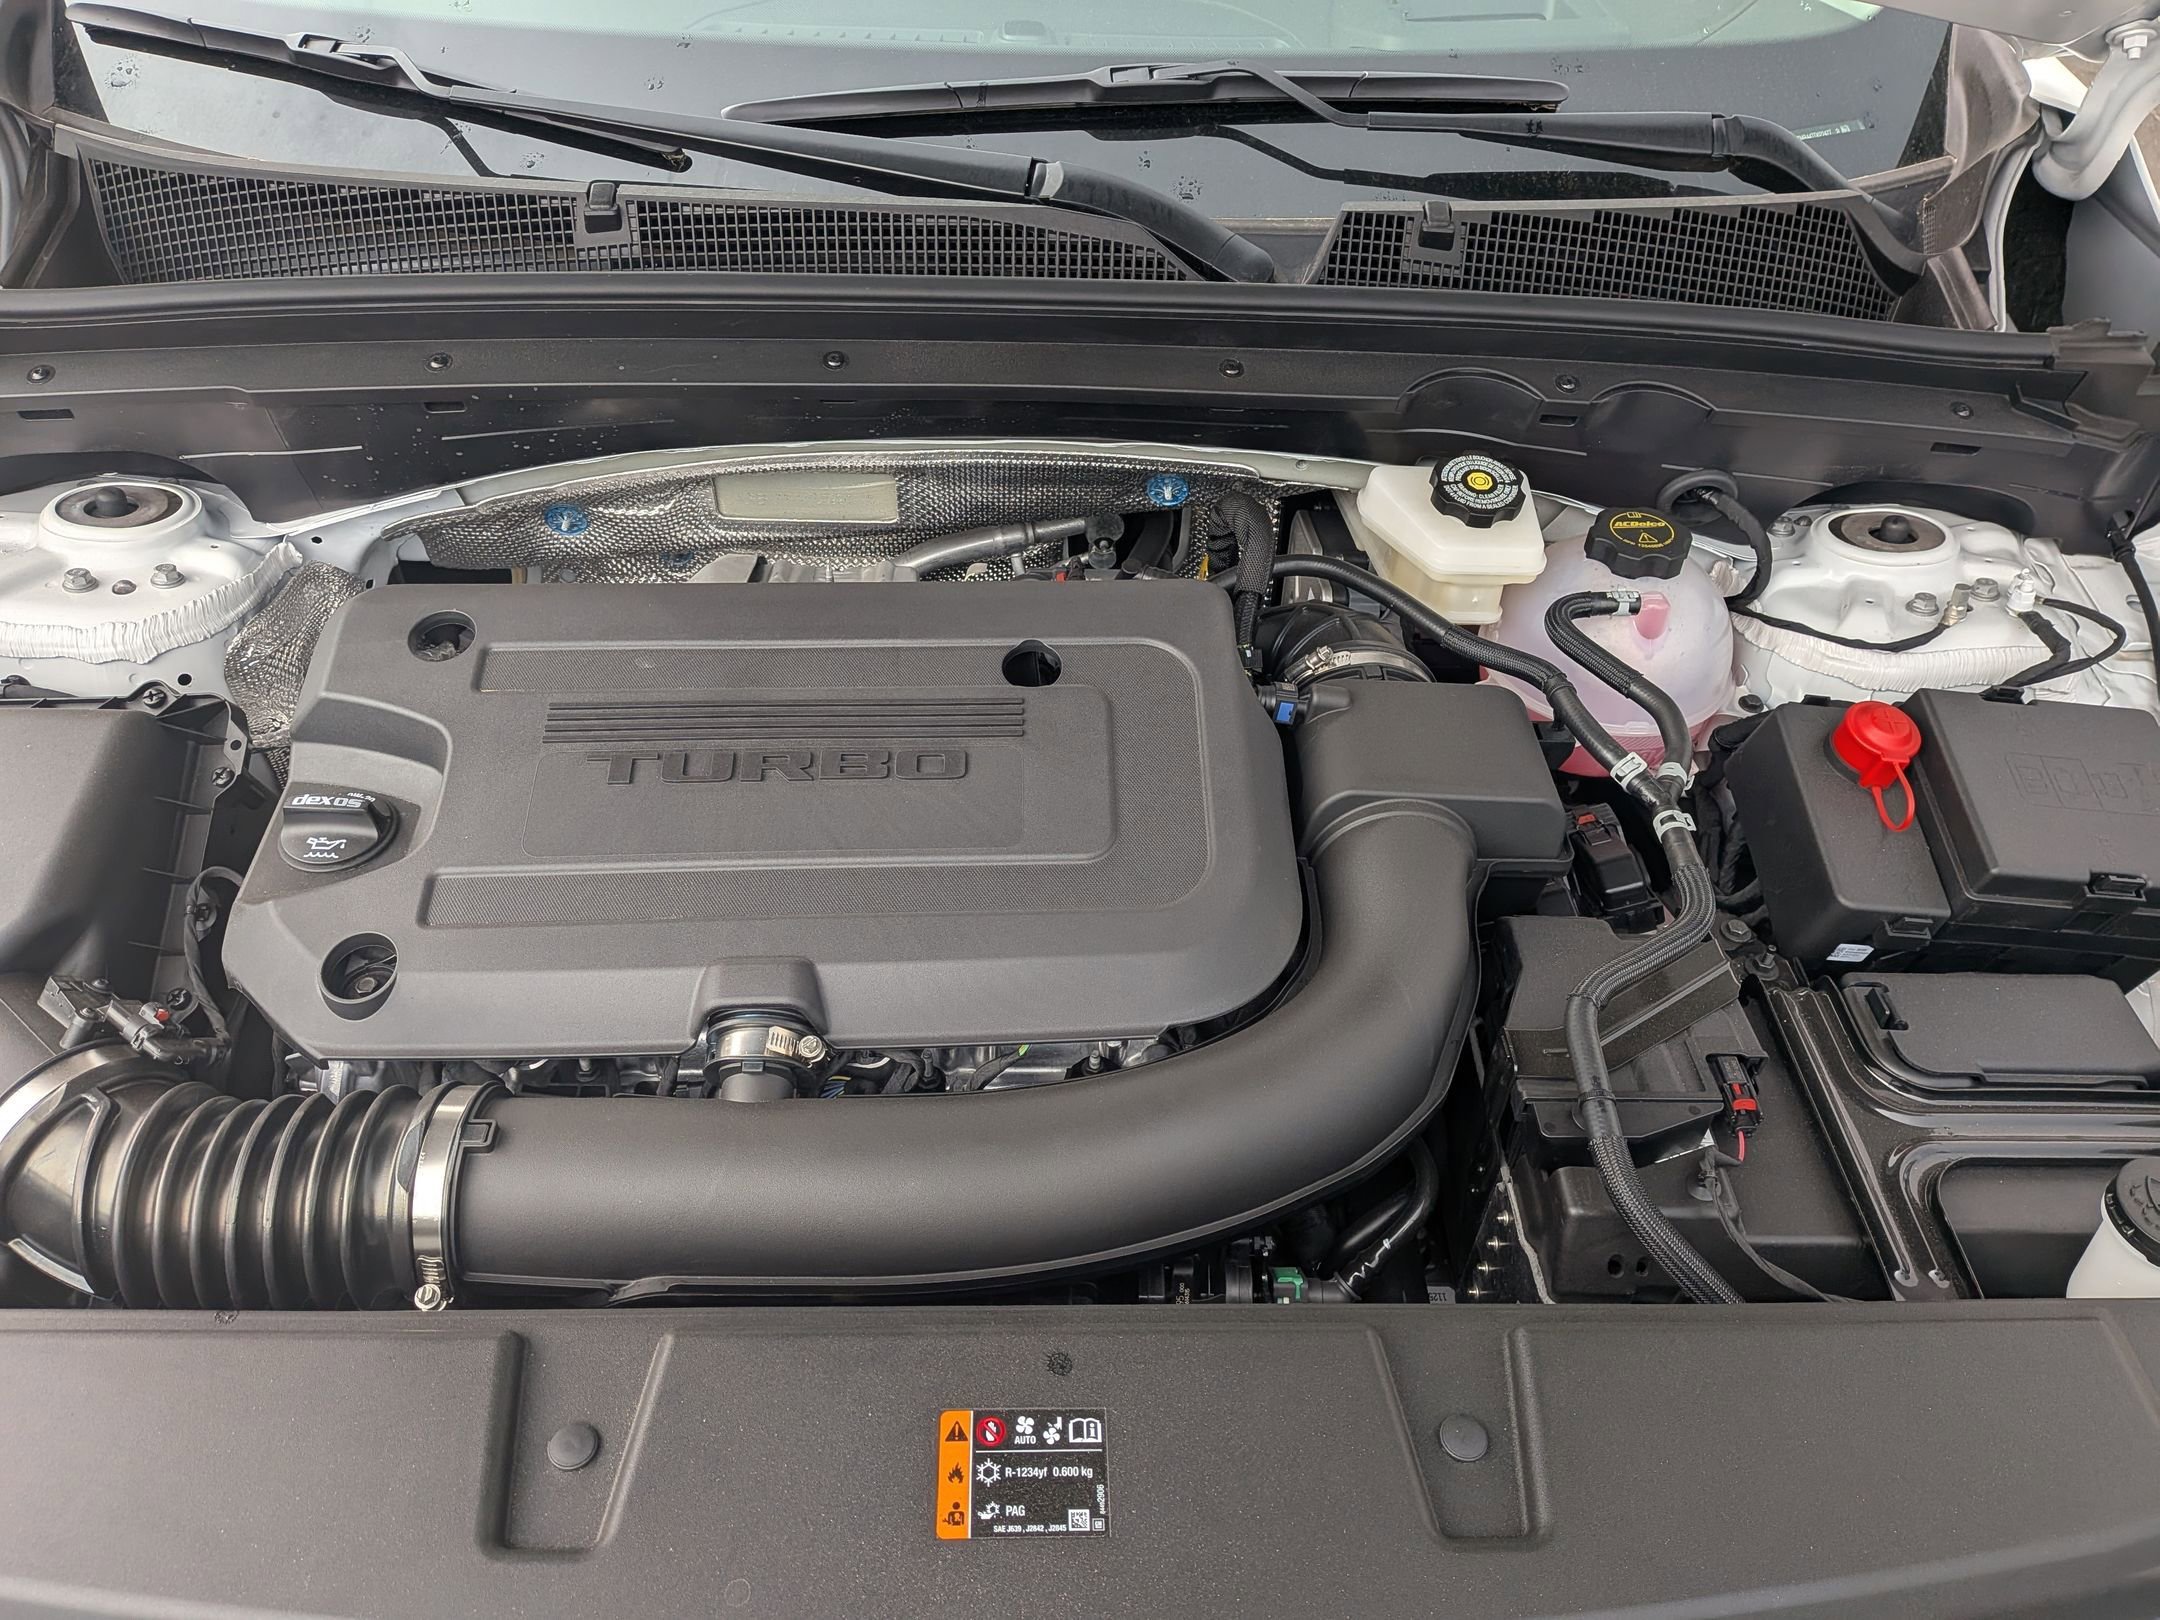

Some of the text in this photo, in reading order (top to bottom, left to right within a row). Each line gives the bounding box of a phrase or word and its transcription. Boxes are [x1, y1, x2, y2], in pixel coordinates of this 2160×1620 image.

[586, 749, 969, 785] TURBO
[292, 793, 365, 808] dexos
[1014, 1435, 1036, 1445] AUTO
[1005, 1466, 1093, 1479] R-1234yf 0.600 kg
[1005, 1505, 1026, 1517] PAG
[993, 1525, 1006, 1533] SAE
